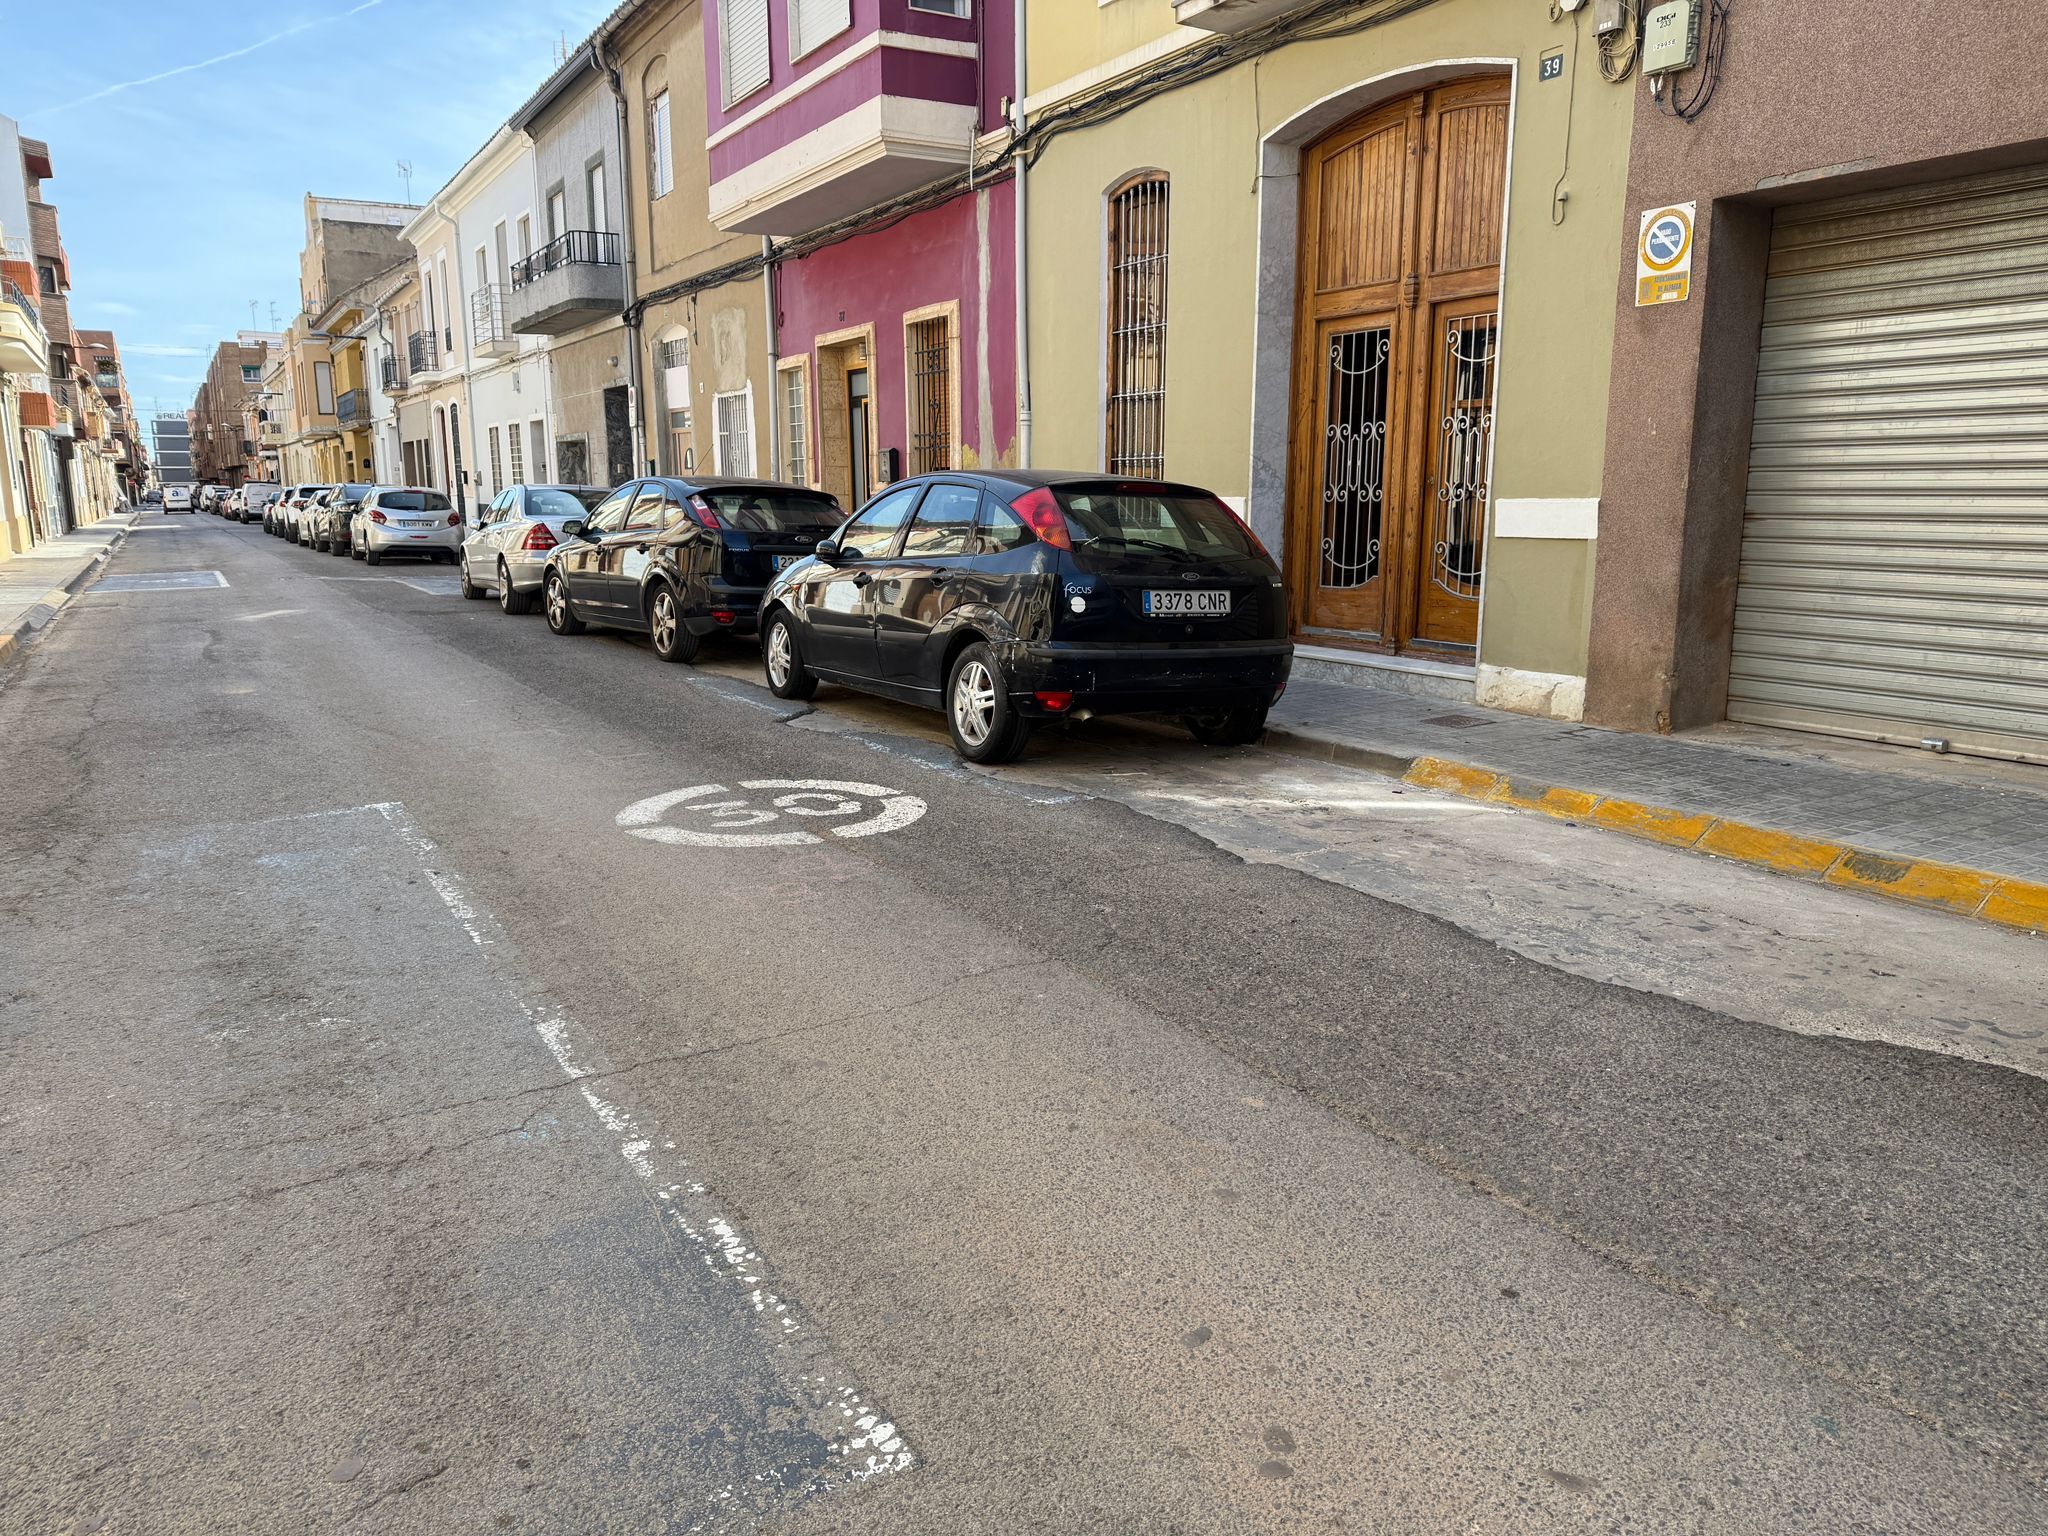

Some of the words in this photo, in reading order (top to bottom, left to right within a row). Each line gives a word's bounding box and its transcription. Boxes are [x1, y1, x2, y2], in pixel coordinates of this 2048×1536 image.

[1656, 12, 1677, 23] DIGI
[1659, 19, 1672, 29] 233
[1544, 58, 1560, 76] 39
[1154, 592, 1193, 611] 3378
[1197, 592, 1228, 611] CNR
[684, 792, 863, 828] 30
